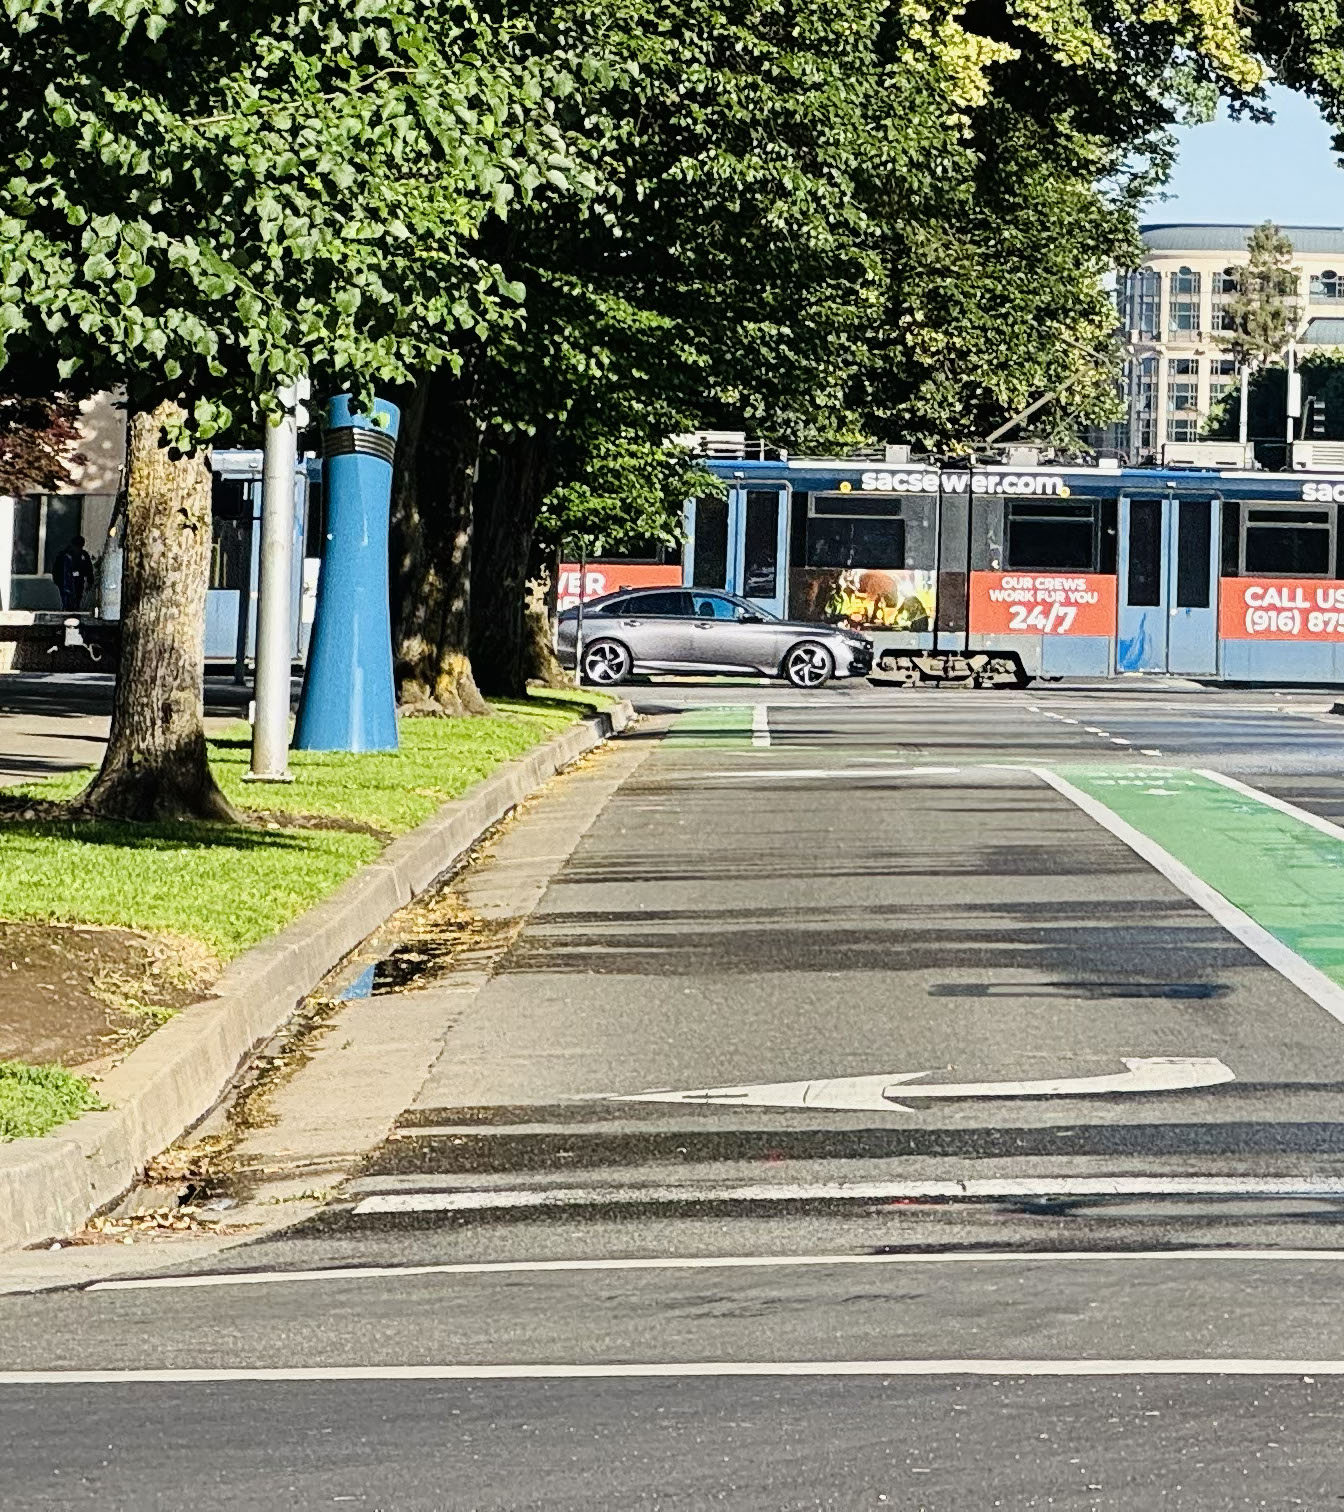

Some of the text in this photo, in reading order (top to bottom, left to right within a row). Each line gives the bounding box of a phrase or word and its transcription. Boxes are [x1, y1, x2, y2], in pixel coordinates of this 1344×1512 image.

[861, 471, 1064, 495] sacsewer.com
[1001, 576, 1087, 590] OUR CREWS
[988, 589, 1098, 604] WORK FOR YOU
[1243, 586, 1311, 609] CALL
[1008, 602, 1078, 634] 24/7
[1245, 607, 1301, 635] (916)
